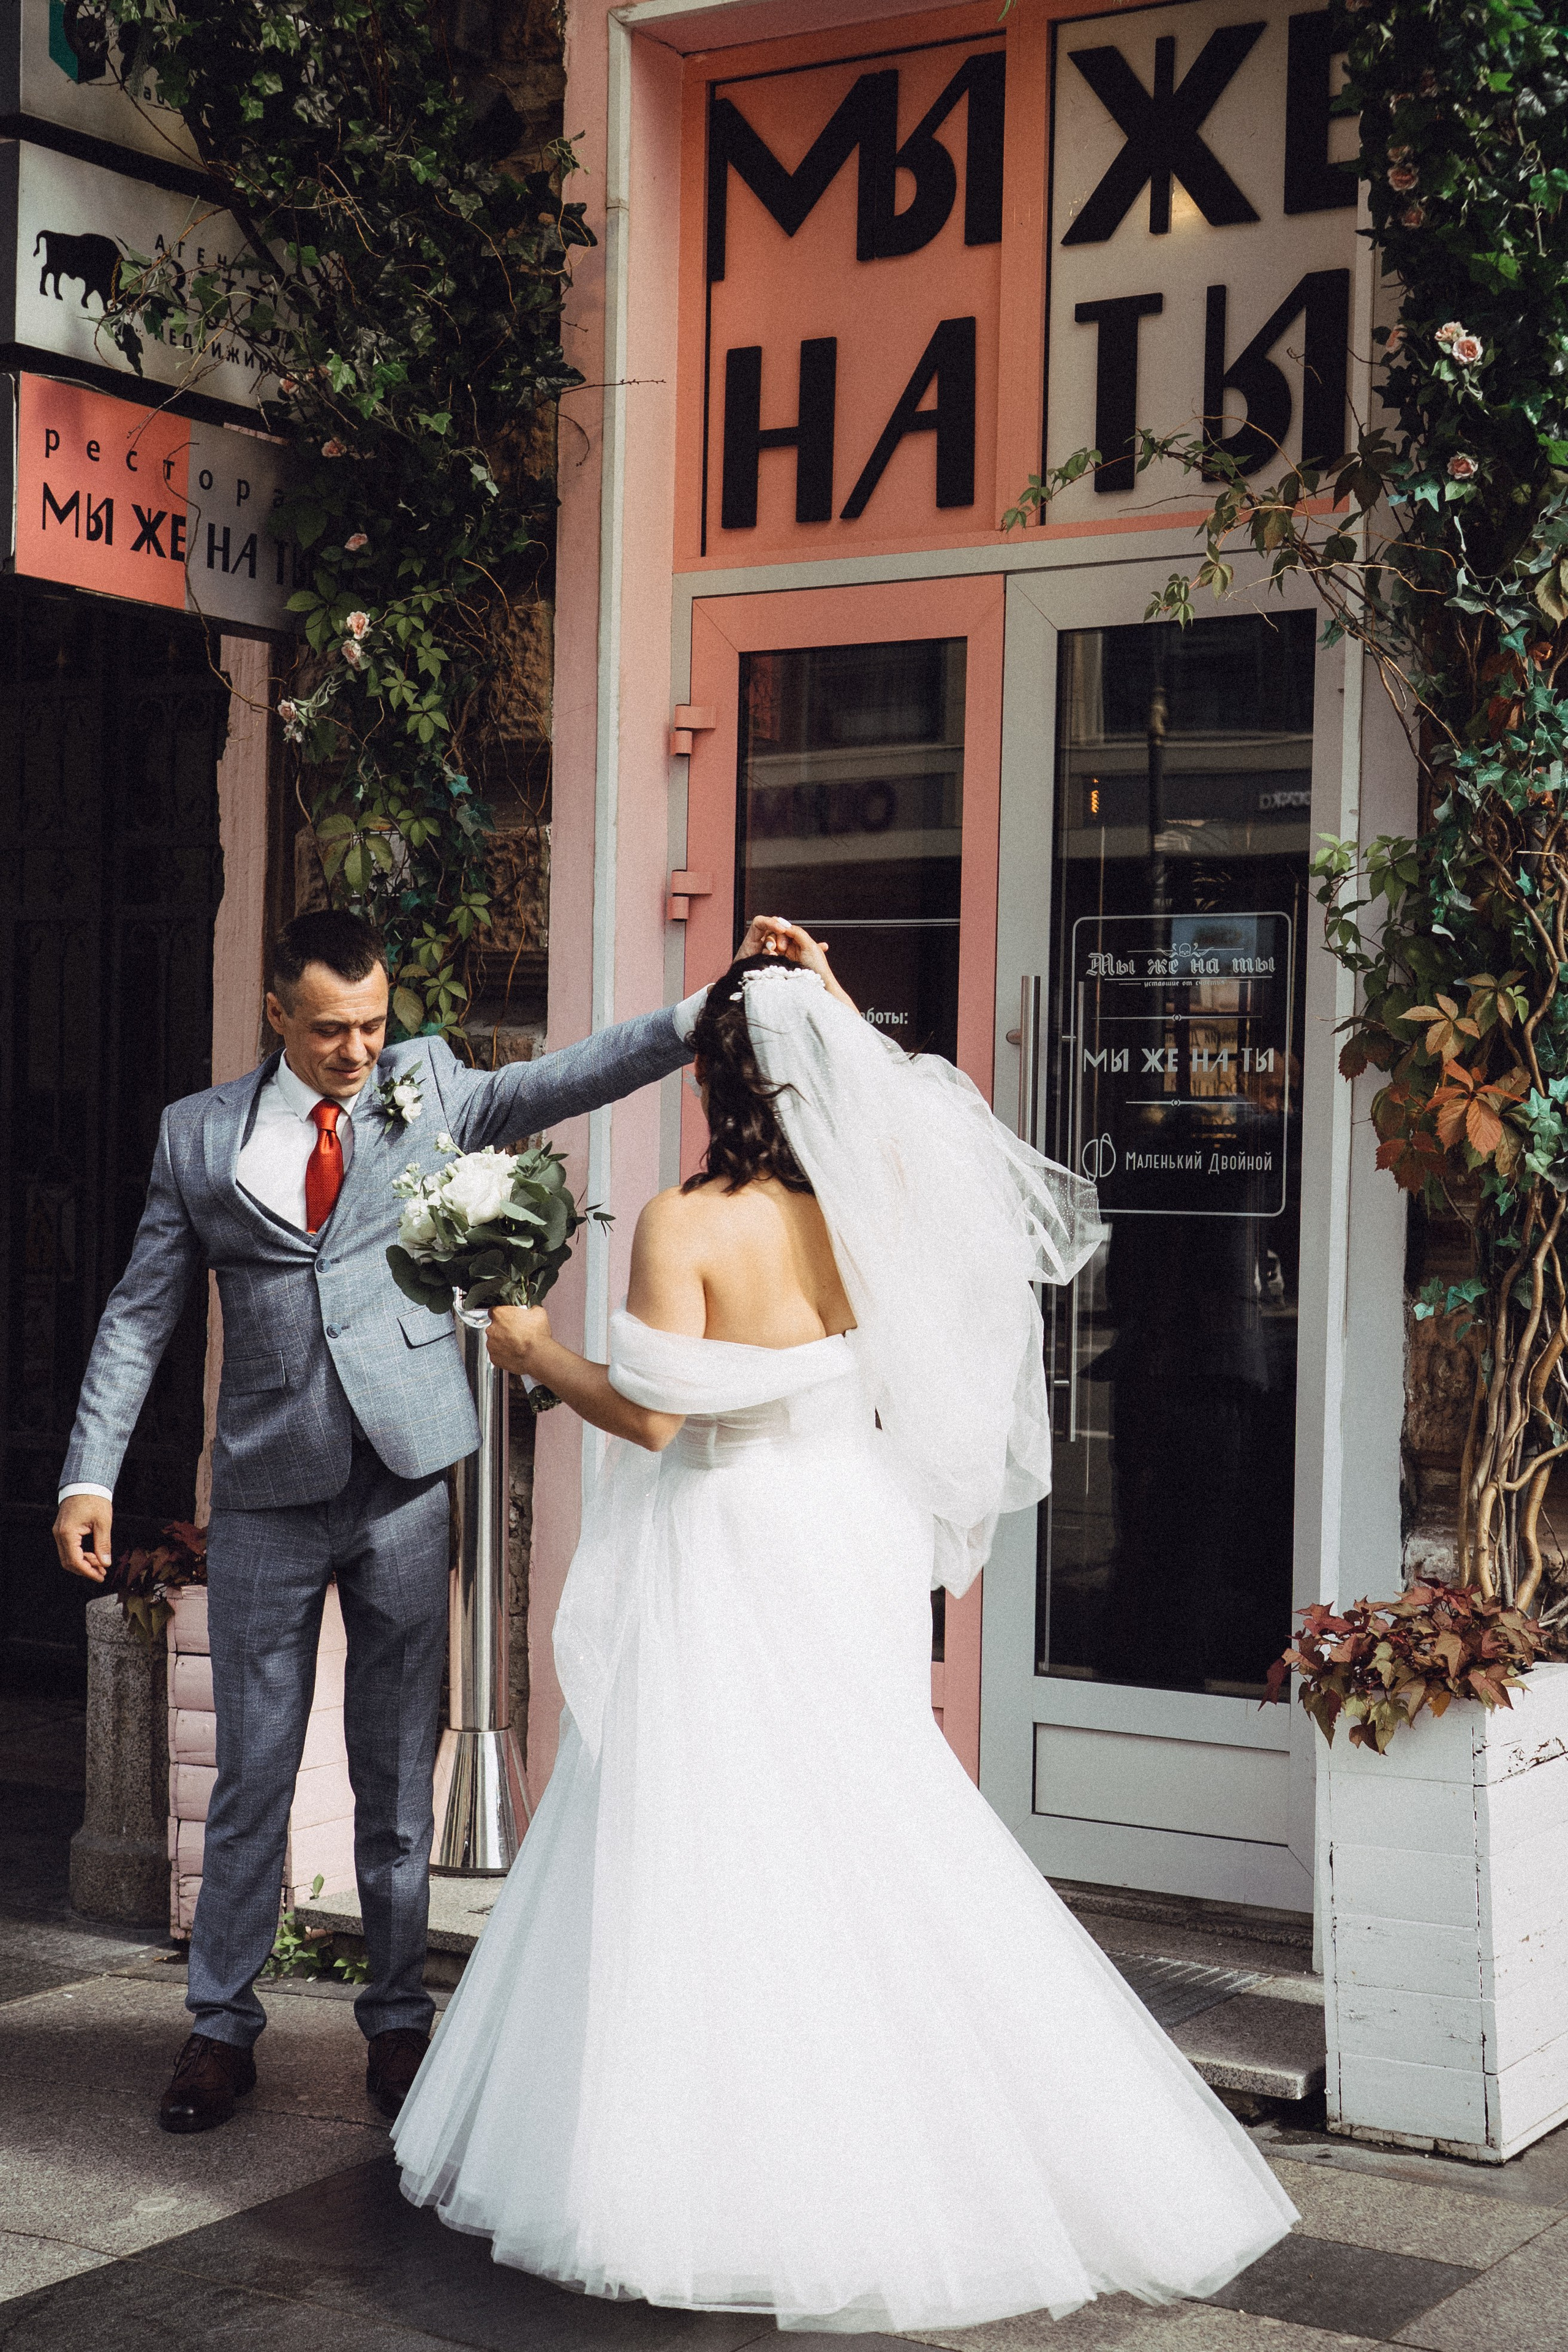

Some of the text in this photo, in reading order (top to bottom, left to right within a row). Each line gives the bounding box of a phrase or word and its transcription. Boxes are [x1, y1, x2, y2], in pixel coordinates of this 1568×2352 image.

[706, 9, 1359, 282] МЫ ЖЕ
[721, 268, 1351, 530] НА ТЫ
[45, 428, 285, 509] рестора
[42, 482, 114, 546] МЫ
[130, 504, 187, 562] ЖЕ
[207, 523, 258, 579] НА
[1085, 952, 1276, 976] Мы же на ты
[861, 1007, 908, 1025] боты:
[1082, 1047, 1275, 1073] МЫ ЖЕ НА ТЫ
